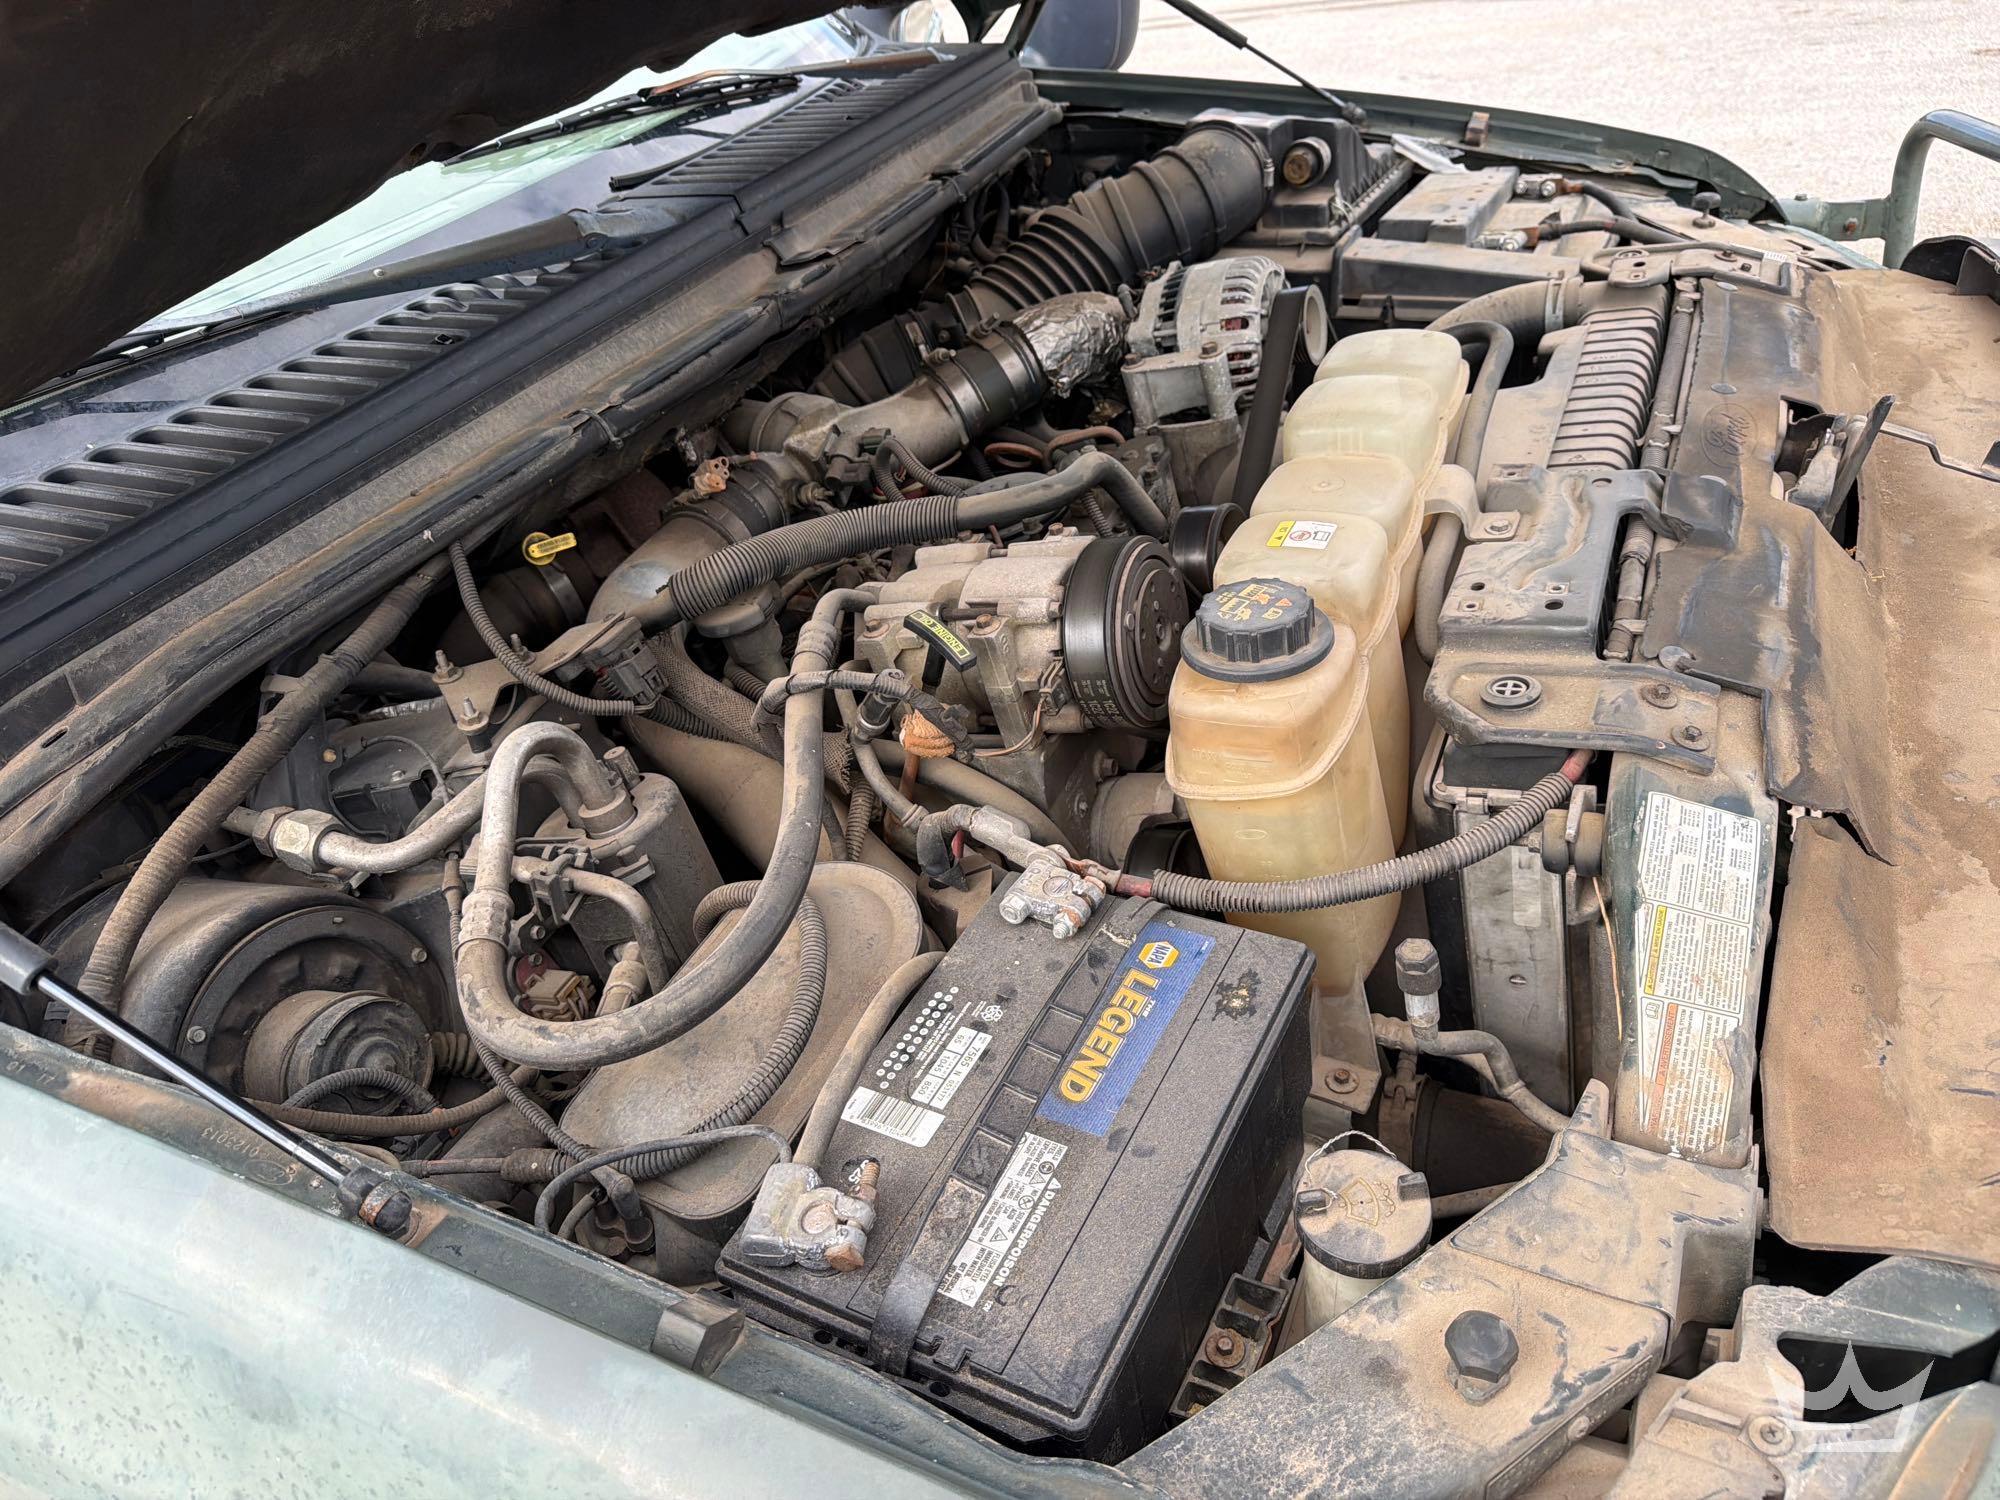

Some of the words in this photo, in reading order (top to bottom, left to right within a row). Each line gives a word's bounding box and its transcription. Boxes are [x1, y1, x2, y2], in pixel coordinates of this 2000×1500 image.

[919, 613, 935, 628] OIL
[931, 624, 964, 652] ENGINE
[1147, 943, 1170, 965] NAPA
[1141, 999, 1156, 1017] THE
[952, 1034, 965, 1044] 65
[1054, 966, 1161, 1103] LEGEND
[1660, 1010, 1675, 1070] AVERTISSEMENT
[933, 1054, 951, 1072] 1045
[959, 1045, 981, 1067] 7565
[917, 1080, 932, 1095] 850
[992, 1189, 1056, 1286] DANGER/POISON
[970, 1249, 994, 1282] IMMEDIATELY
[986, 1252, 1001, 1269] FLUSH
[943, 1271, 962, 1294] MEDICAL
